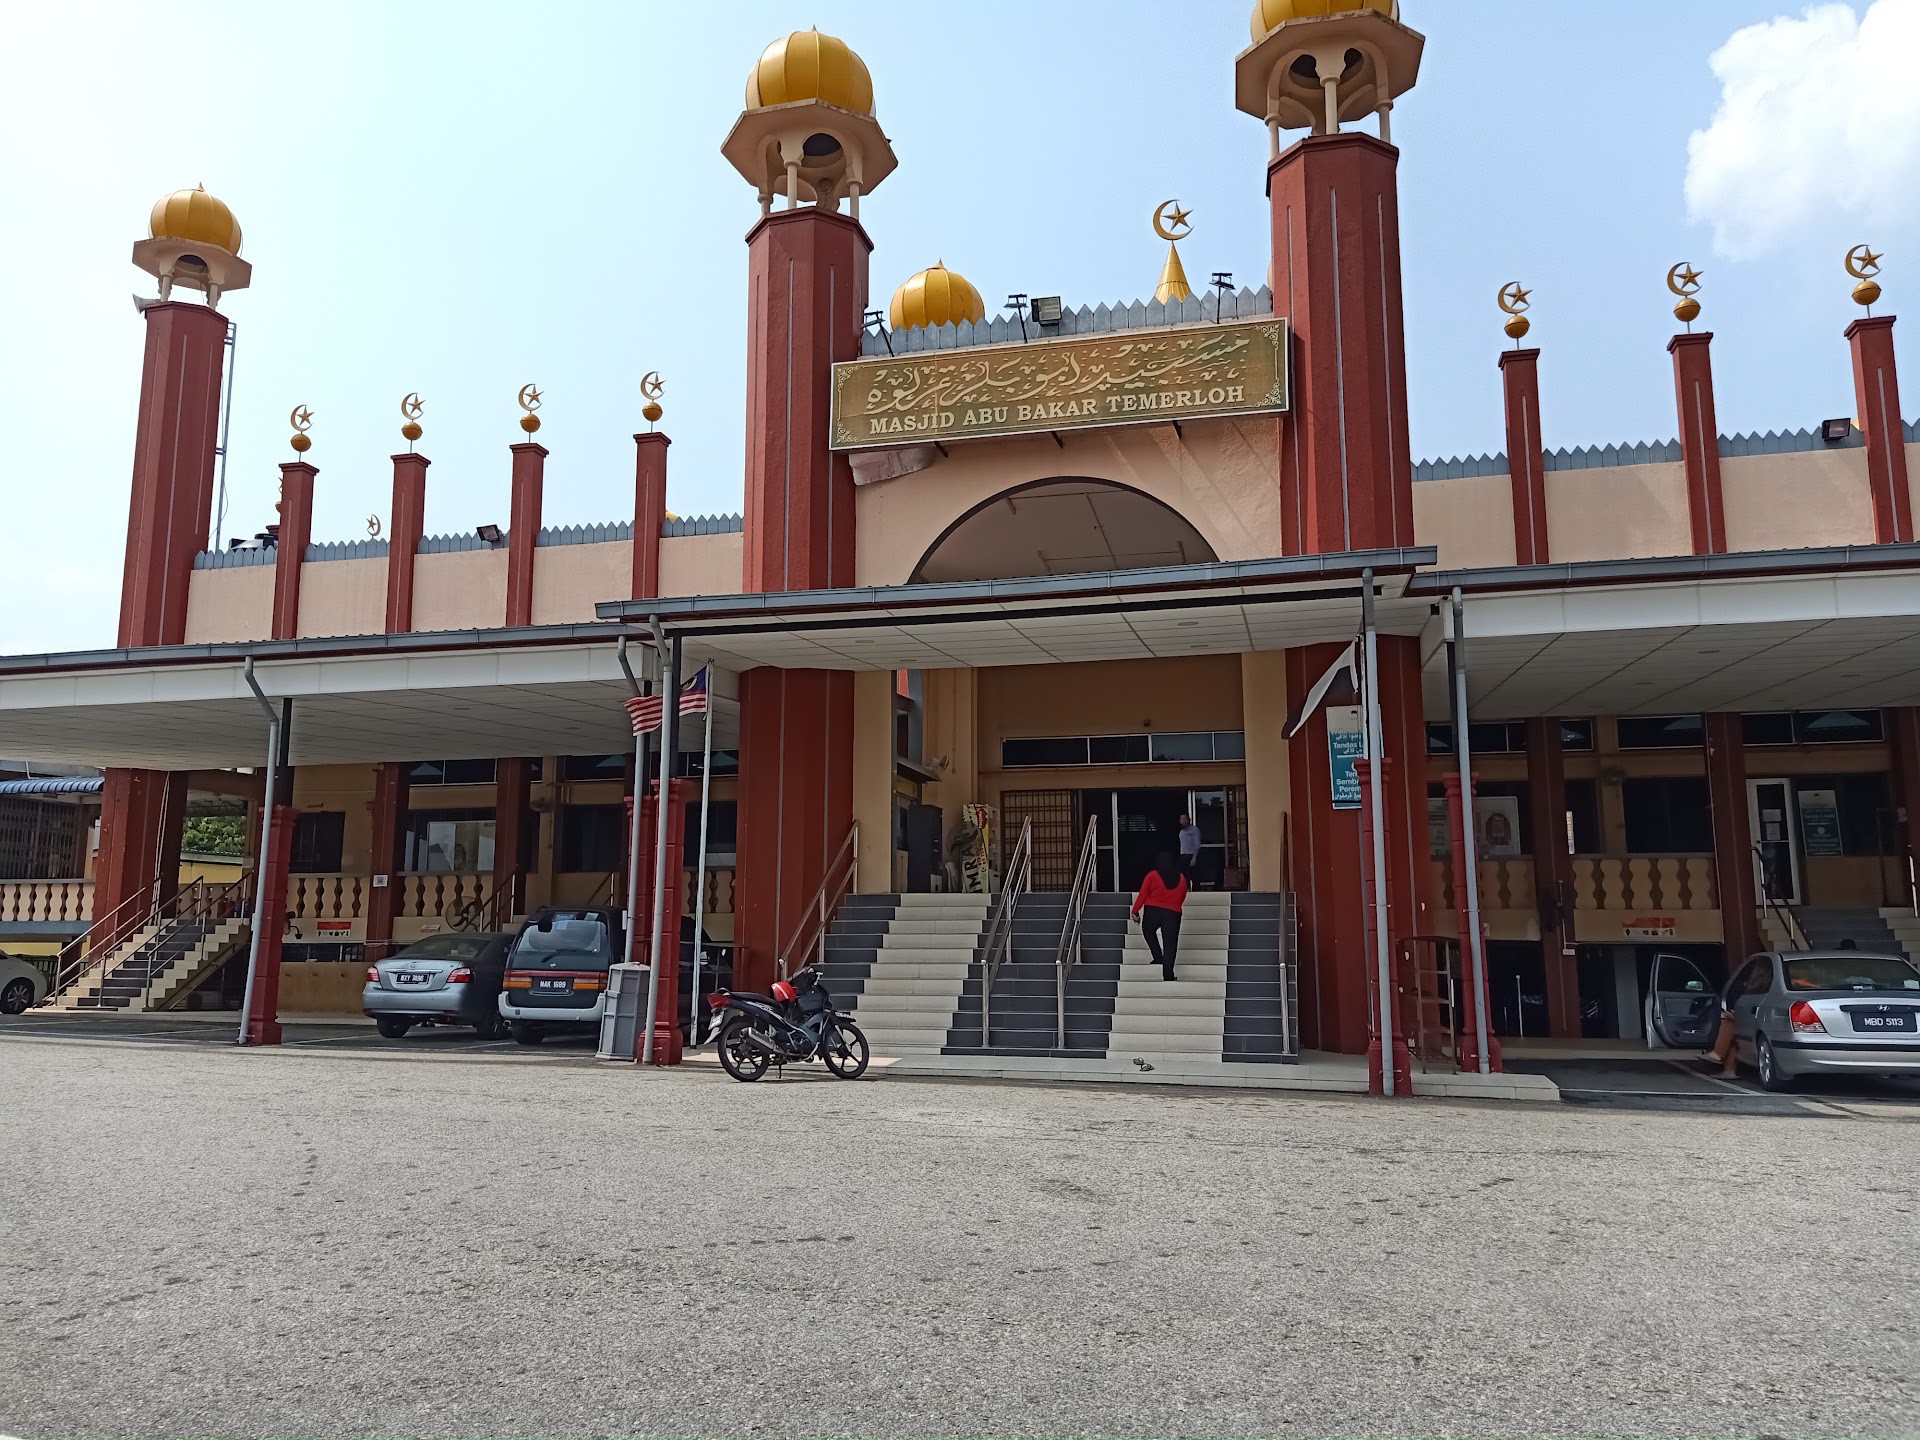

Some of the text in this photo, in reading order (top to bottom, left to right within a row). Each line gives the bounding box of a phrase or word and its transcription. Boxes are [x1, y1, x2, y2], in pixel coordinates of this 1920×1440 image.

[869, 385, 1245, 435] MASJID ABU BAKAR TEMERLOH
[540, 980, 551, 988] MAK
[1864, 1017, 1904, 1027] MBD 5113
